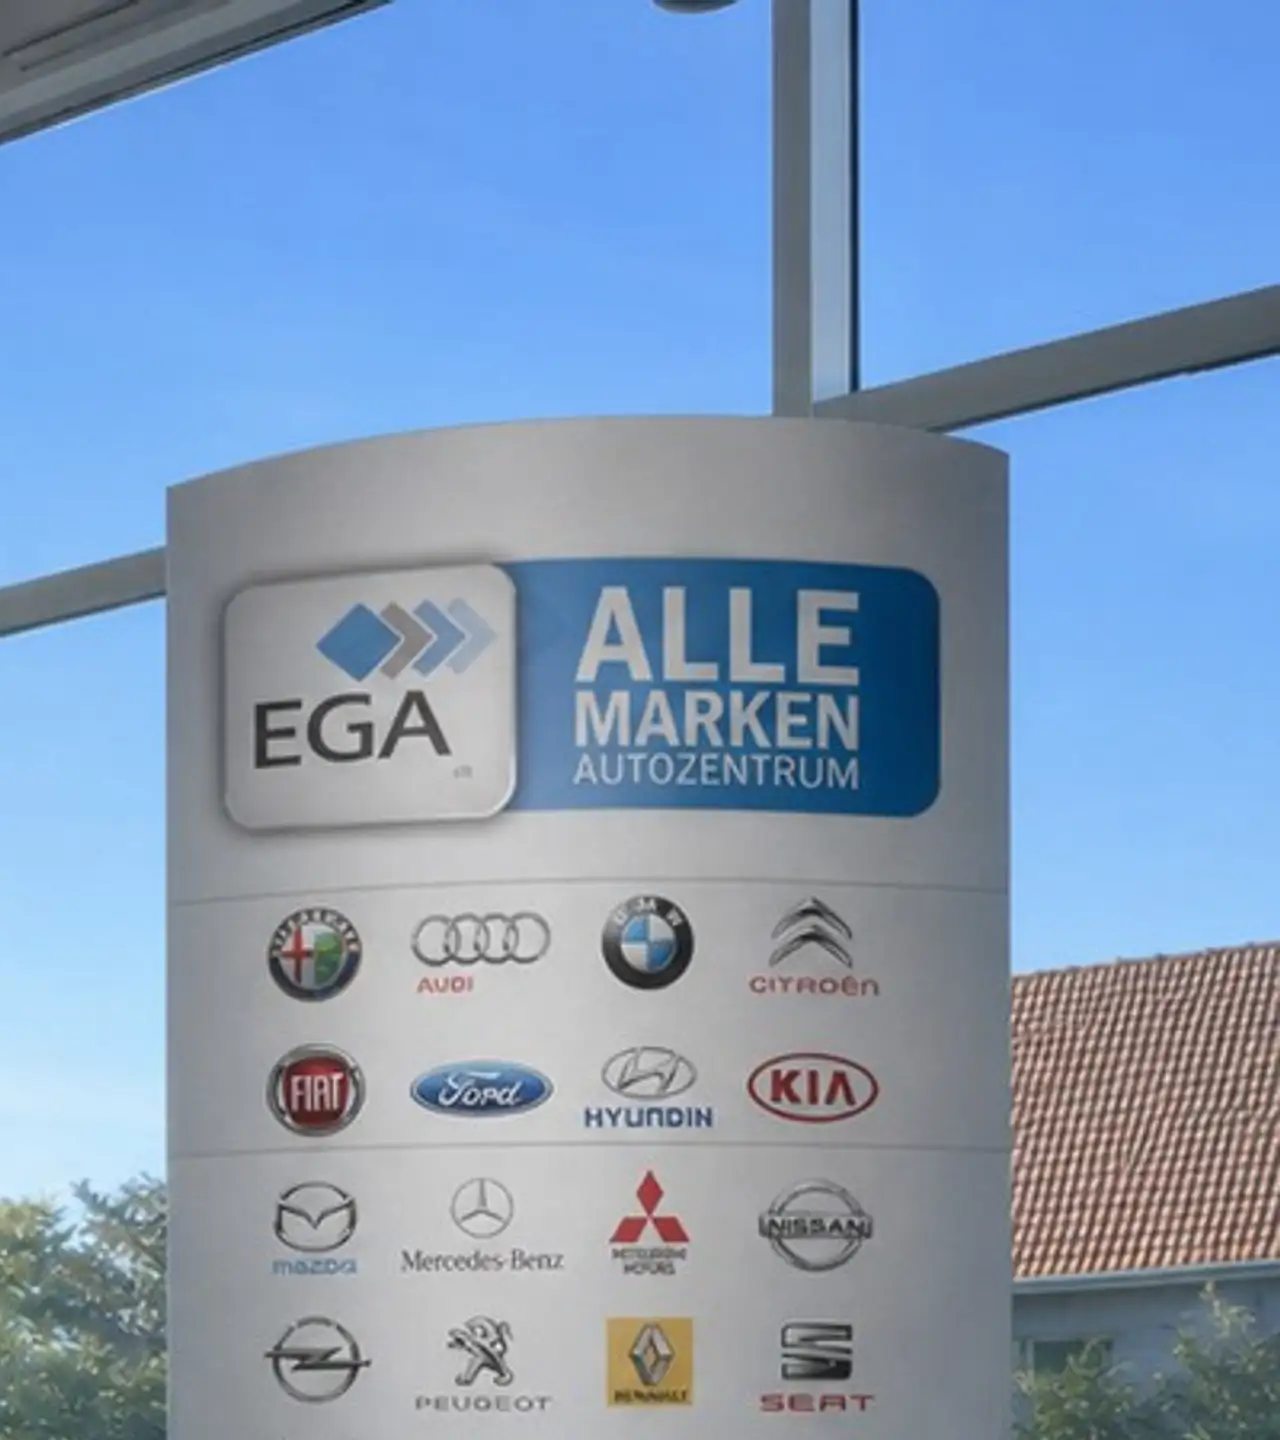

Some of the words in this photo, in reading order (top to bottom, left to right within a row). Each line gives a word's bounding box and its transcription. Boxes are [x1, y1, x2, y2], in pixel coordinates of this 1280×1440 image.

[574, 584, 860, 687] ALLE
[253, 690, 452, 770] EGA
[573, 690, 860, 750] MARKEN
[572, 752, 860, 789] AUTOZENTRUM
[290, 1072, 344, 1112] FIAT
[438, 1070, 524, 1107] Ford
[770, 1069, 857, 1106] KIA
